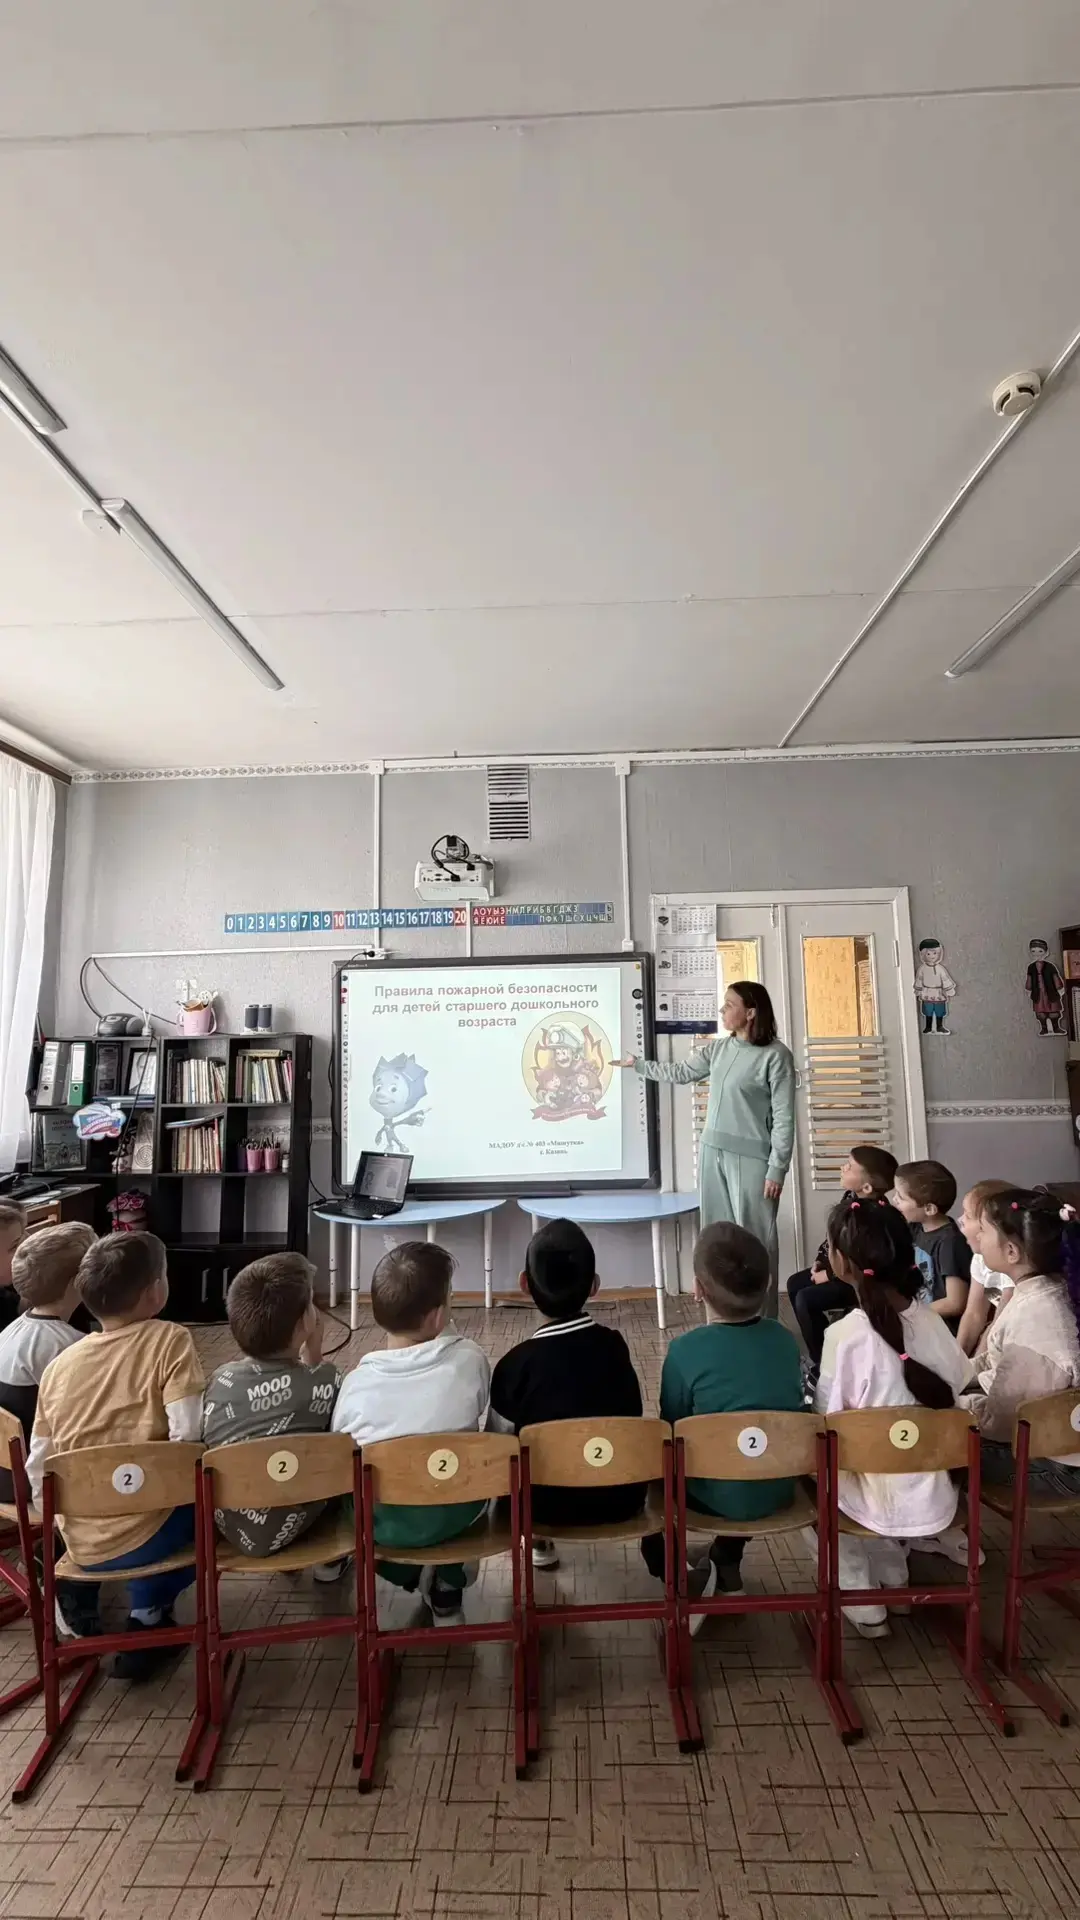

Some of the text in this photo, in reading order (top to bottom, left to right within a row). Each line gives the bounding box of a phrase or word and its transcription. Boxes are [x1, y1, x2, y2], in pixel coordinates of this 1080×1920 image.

[226, 910, 466, 930] 0 1 2 3 4 5 6 7 8 9 10 11 12 13 14 15 16 17 18 19 20
[374, 982, 598, 998] Правила пожарной безопасности
[372, 999, 599, 1014] для детей старшего дошкольного
[457, 1016, 517, 1029] возраста
[246, 1374, 292, 1402] MOOD
[748, 1436, 758, 1448] 2
[900, 1430, 908, 1441] 2
[594, 1446, 602, 1459] 2
[278, 1461, 288, 1474] 2
[438, 1460, 447, 1472] 2
[124, 1473, 133, 1486] 2
[269, 1512, 298, 1551] MOOD
